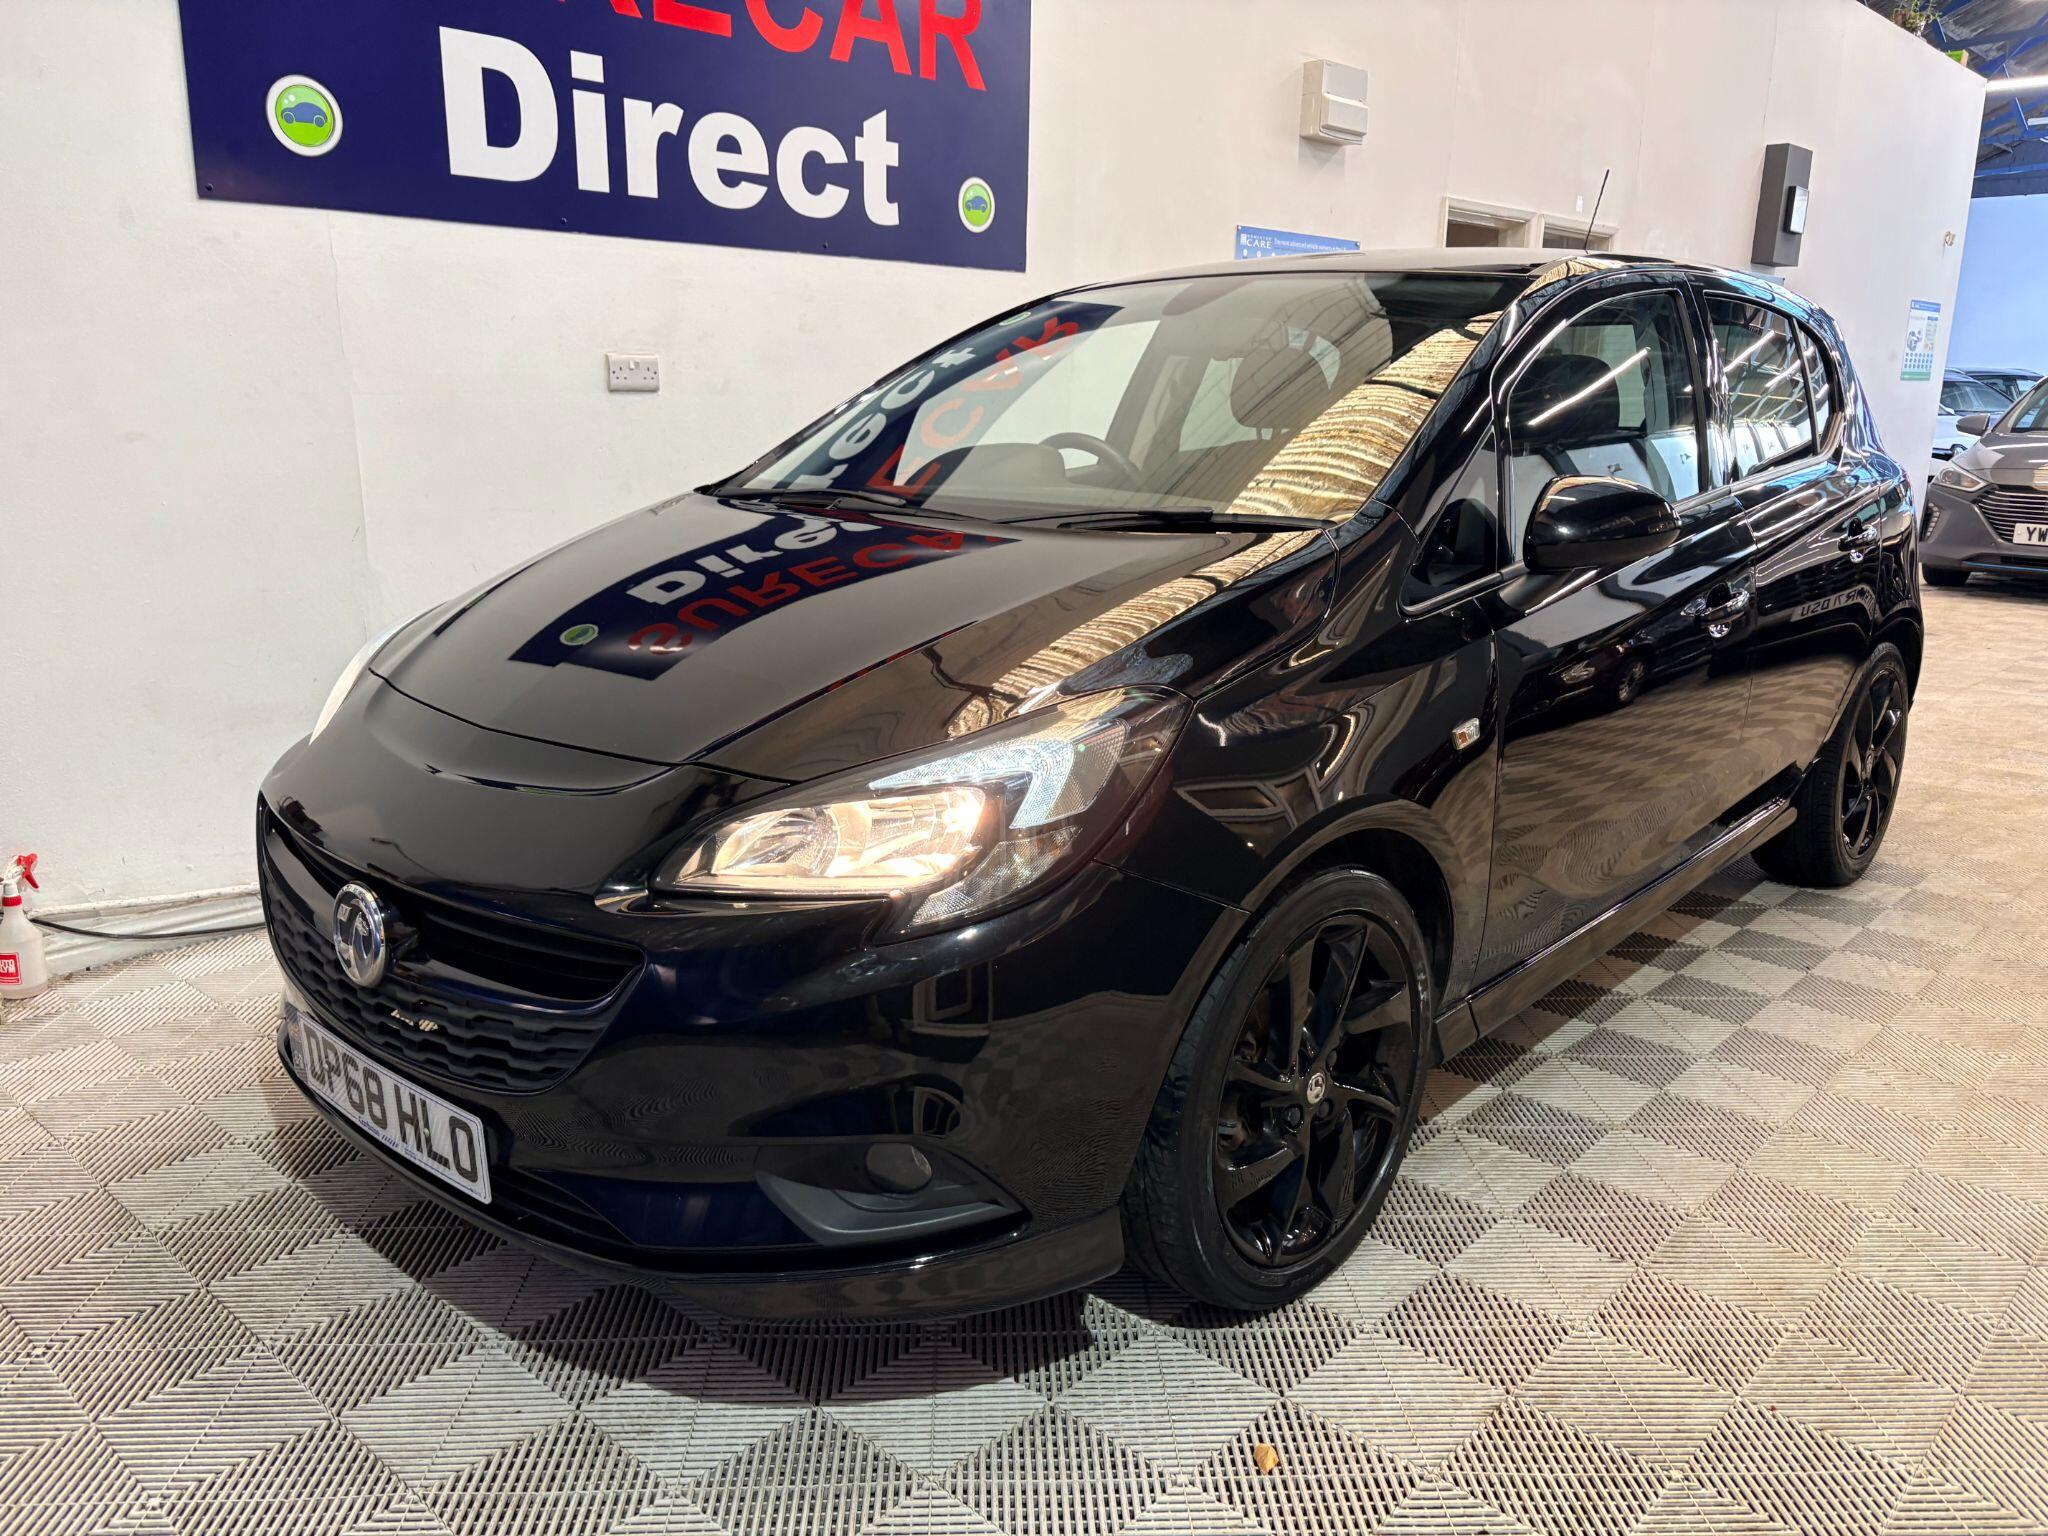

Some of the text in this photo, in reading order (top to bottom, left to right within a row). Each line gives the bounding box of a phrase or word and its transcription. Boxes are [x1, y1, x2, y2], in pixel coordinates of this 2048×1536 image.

[439, 26, 901, 227] Direct
[1246, 239, 1273, 250] CARE
[303, 1023, 479, 1184] DP68 HLO
